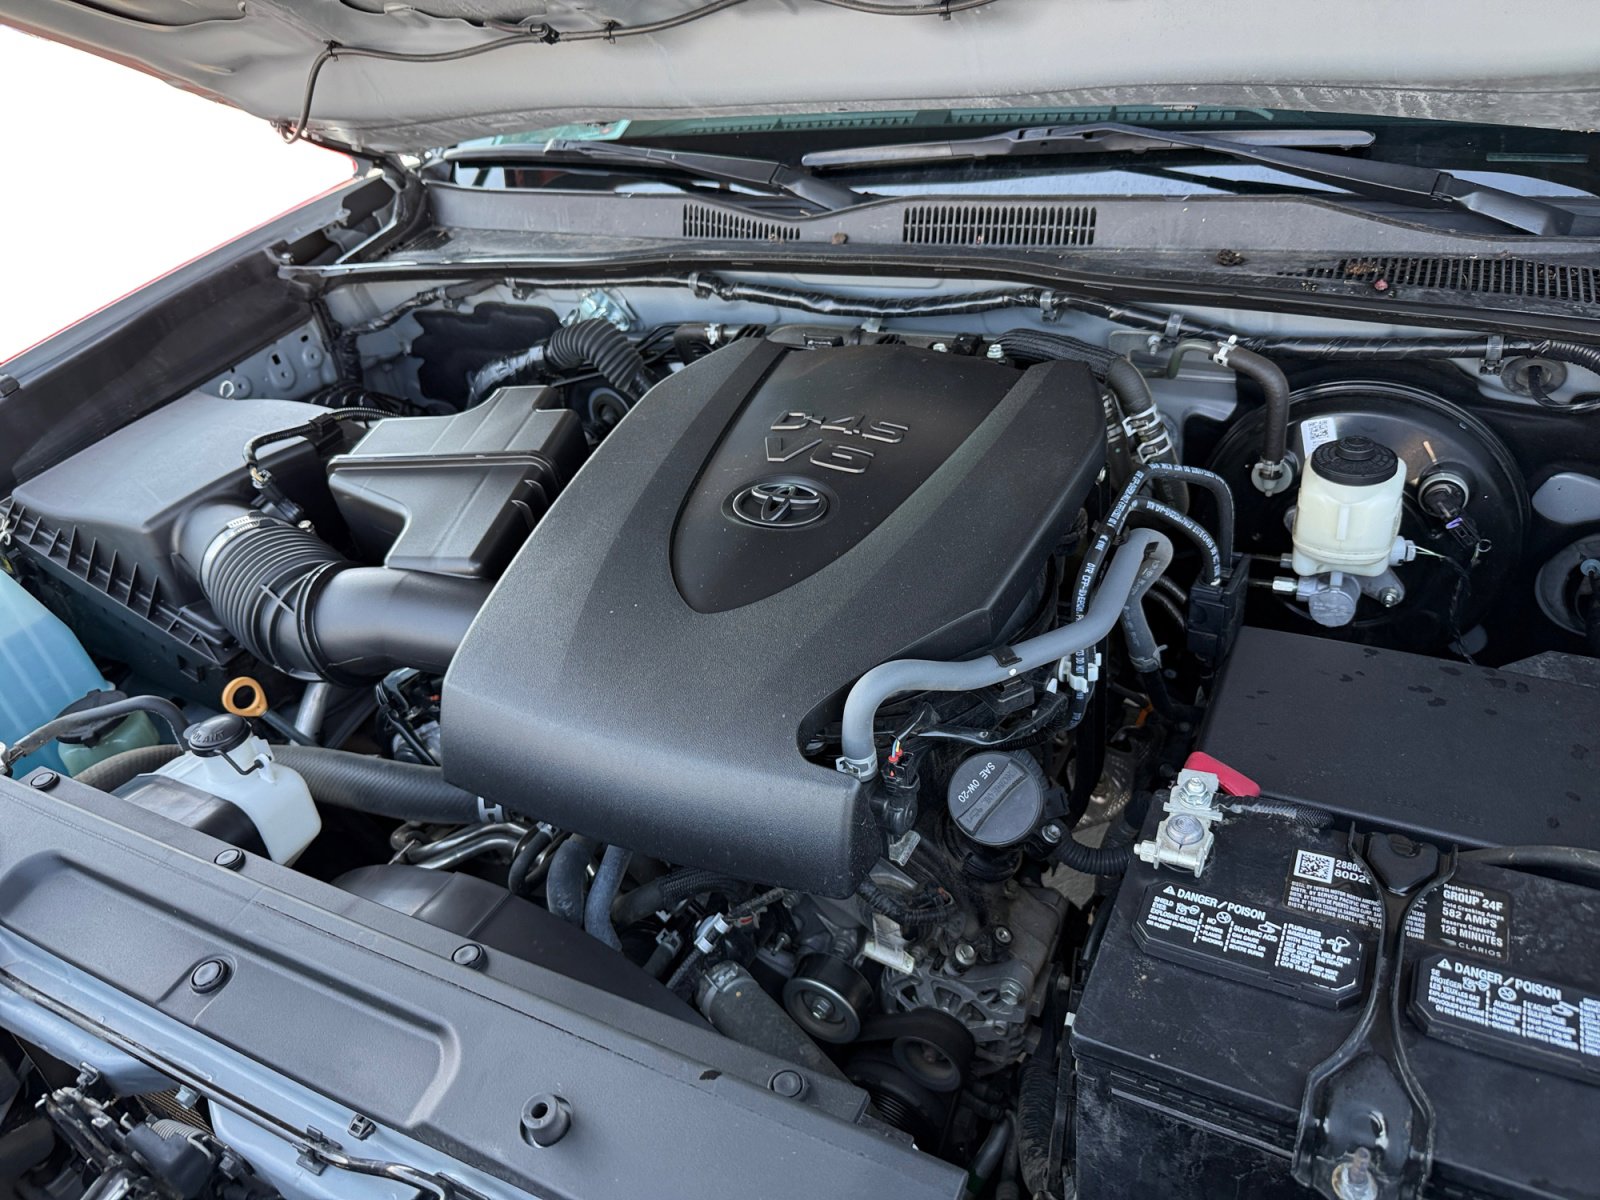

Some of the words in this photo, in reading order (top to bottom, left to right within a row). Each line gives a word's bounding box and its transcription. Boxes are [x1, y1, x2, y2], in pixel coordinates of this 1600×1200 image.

[765, 436, 875, 474] V6
[978, 761, 997, 781] SAE
[956, 778, 982, 804] 0W-20
[1336, 859, 1364, 873] 2880
[1443, 883, 1468, 894] Replace
[1469, 889, 1485, 897] With
[1152, 902, 1167, 911] EYES
[1154, 896, 1174, 907] SHIELD
[1339, 897, 1360, 907] PACIFIC
[1362, 898, 1382, 907] AMERIC
[1442, 889, 1480, 906] GROUP
[1481, 898, 1504, 912] 24F
[1150, 907, 1180, 921] EXPLOSIVE
[1442, 901, 1457, 909] Cold
[1457, 905, 1486, 917] Cranking
[1486, 912, 1505, 922] Amps
[1442, 907, 1463, 920] 582
[1464, 913, 1498, 929] AMPS
[1207, 917, 1217, 926] NO
[1288, 923, 1307, 933] FLUSH
[1441, 918, 1467, 929] Reserve
[1468, 924, 1496, 937] Capacity
[1233, 925, 1263, 939] SULFURIC
[1262, 933, 1278, 943] ACID
[1406, 931, 1425, 940] GUAM
[1440, 924, 1458, 936] 125
[1459, 929, 1504, 948] MINUTES
[1458, 942, 1503, 958] CLARIOS
